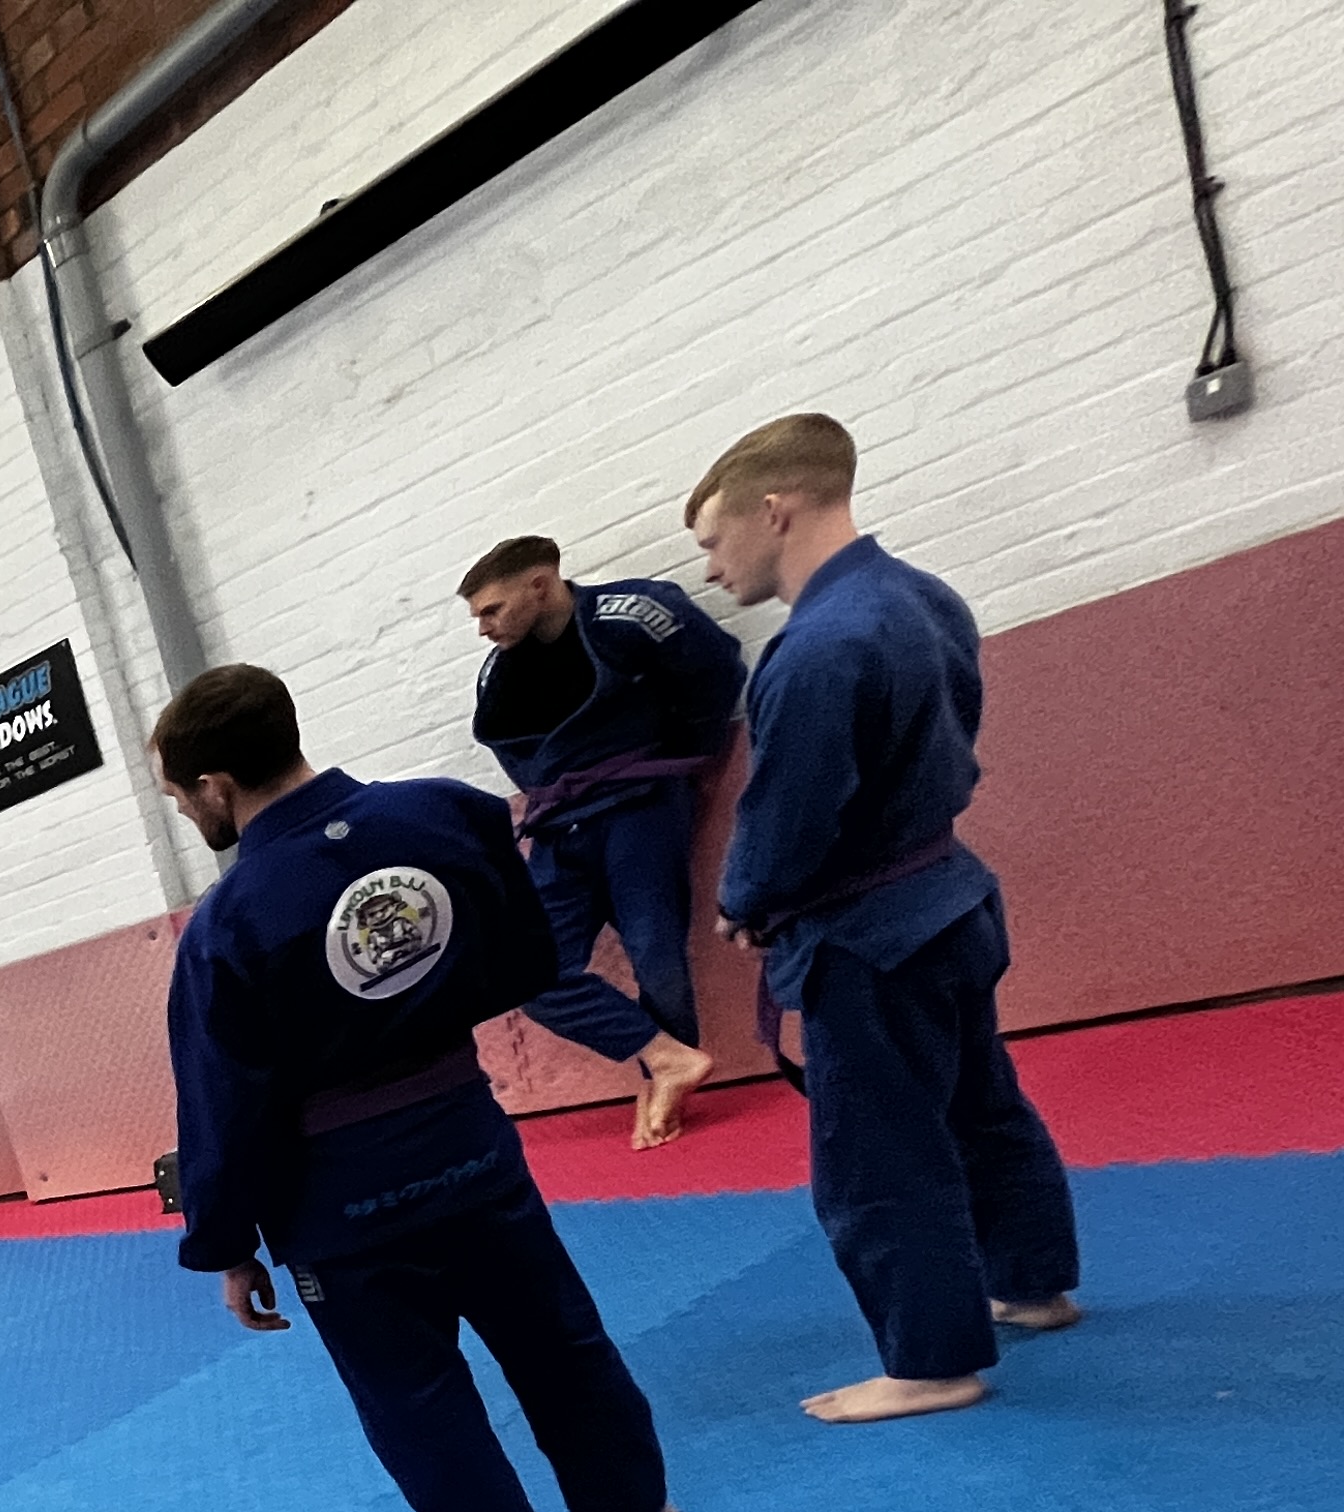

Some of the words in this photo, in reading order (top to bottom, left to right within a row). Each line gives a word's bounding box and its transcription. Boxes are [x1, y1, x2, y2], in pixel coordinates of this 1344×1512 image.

[4, 756, 24, 772] THE
[14, 765, 35, 780] THE
[39, 745, 75, 770] WORST
[336, 878, 384, 931] LINCOLN
[390, 875, 425, 892] BJJ
